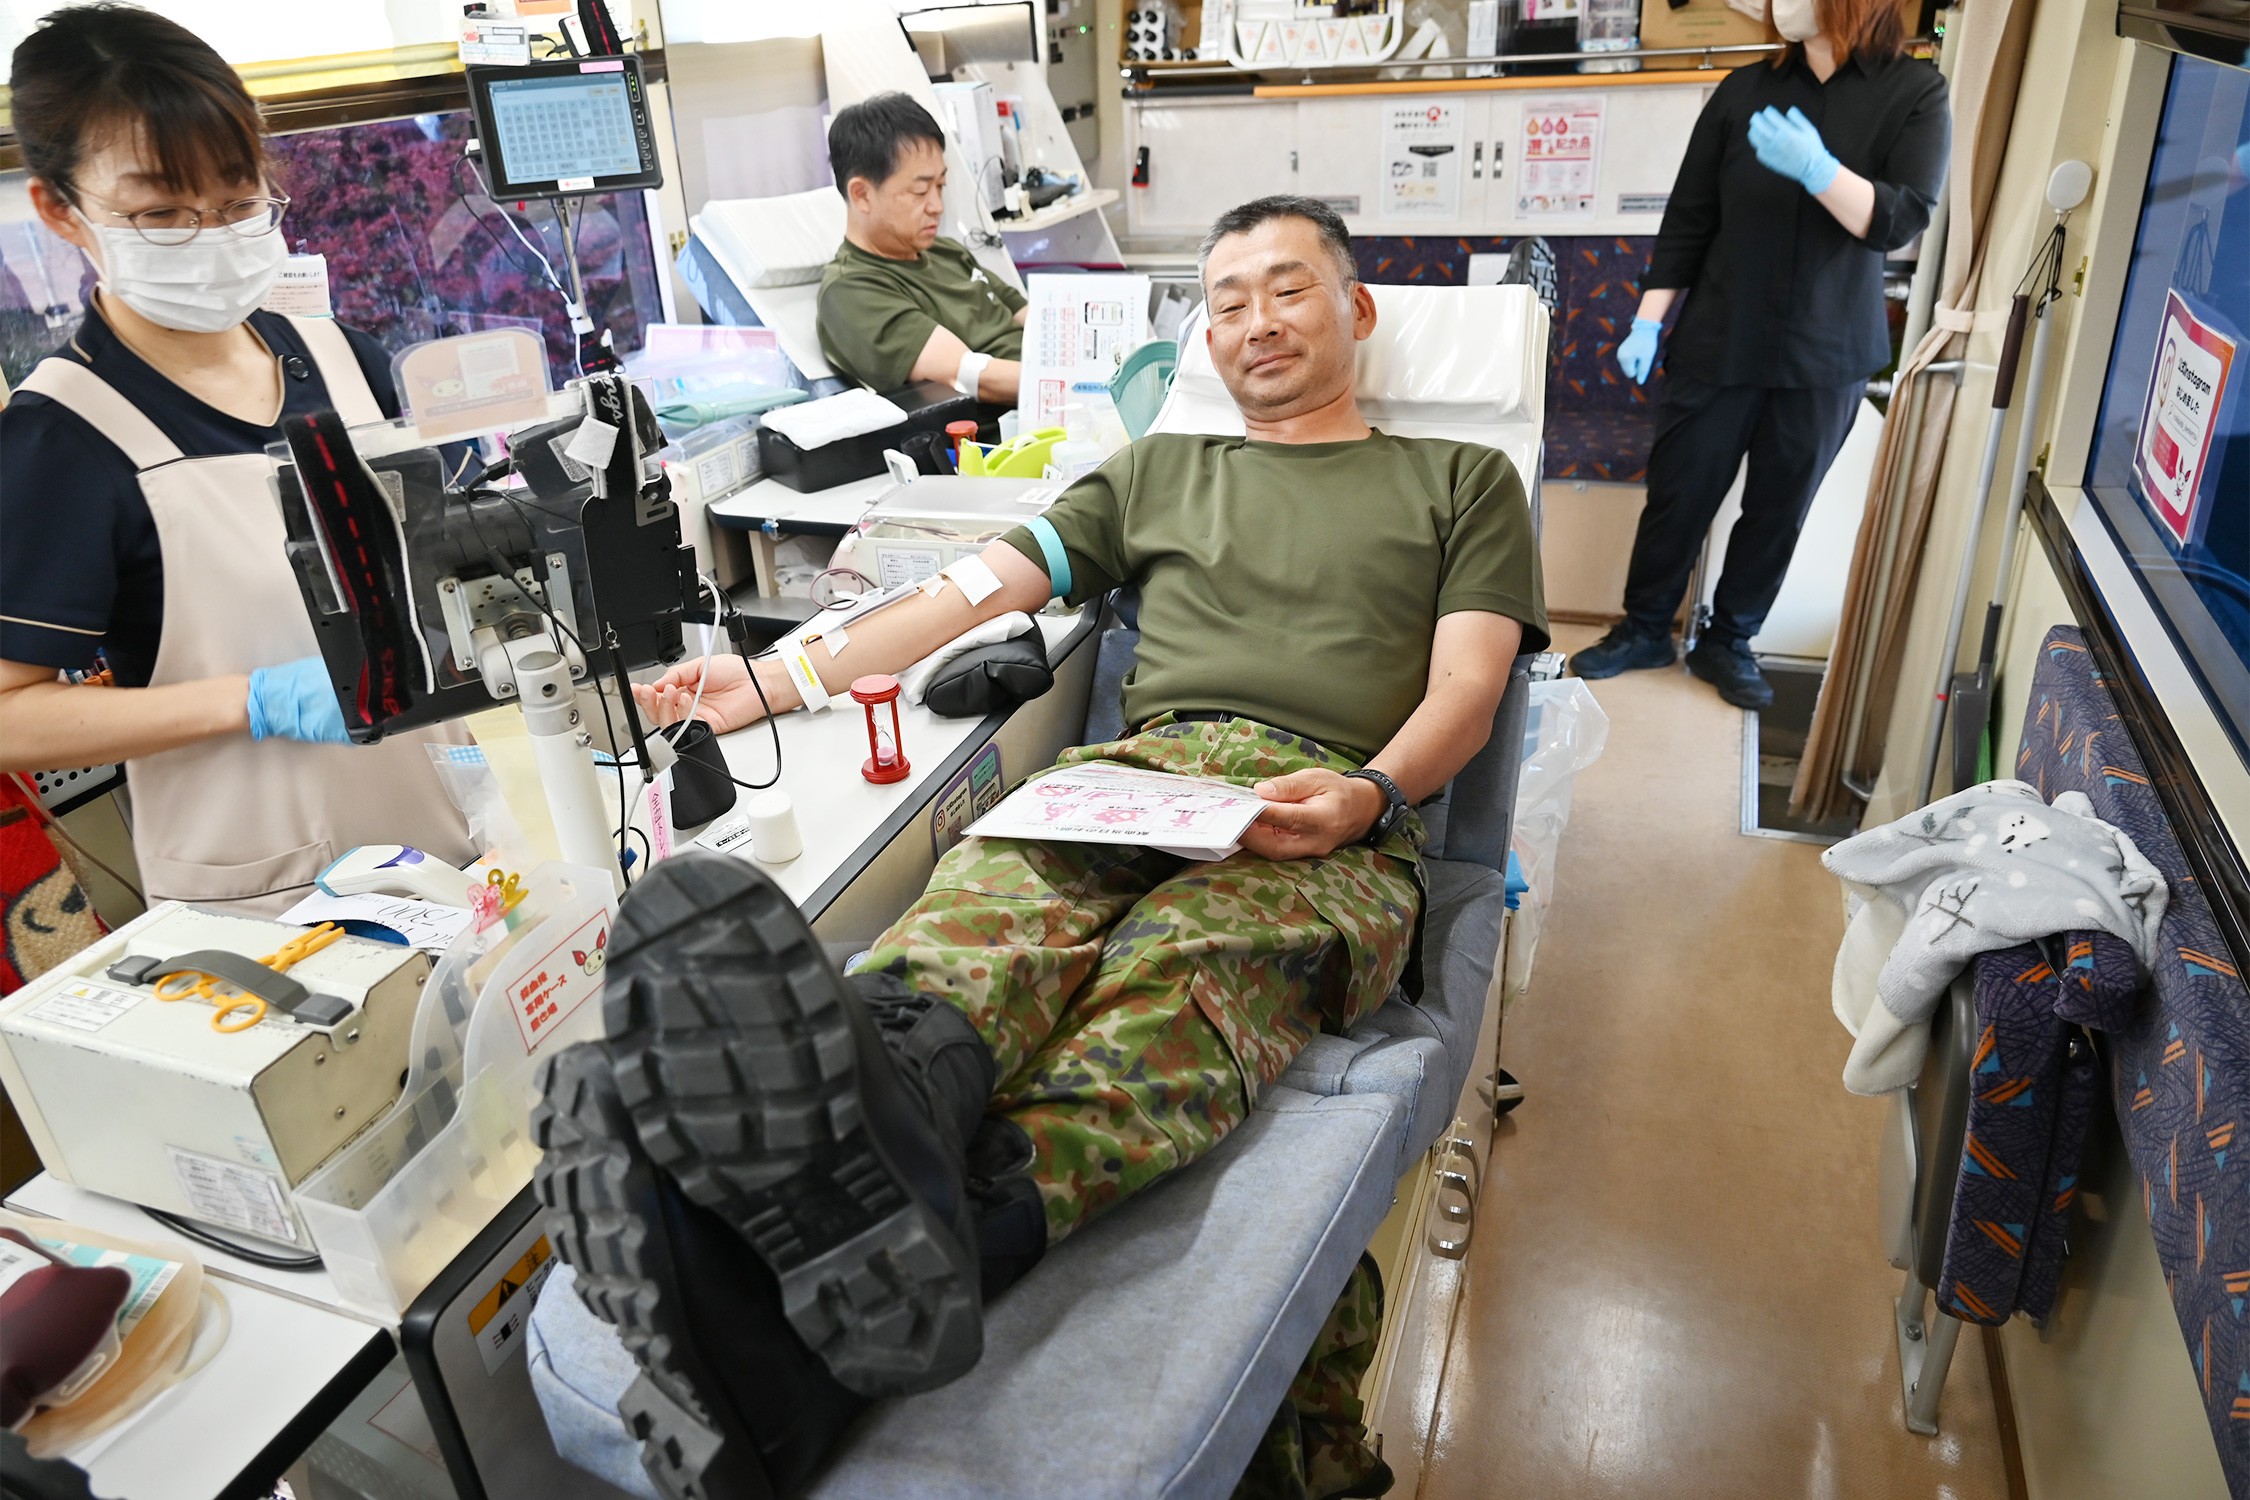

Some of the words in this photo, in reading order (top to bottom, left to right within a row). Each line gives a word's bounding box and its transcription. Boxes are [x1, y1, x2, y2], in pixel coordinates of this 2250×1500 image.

[2175, 385, 2200, 415] はじめました
[525, 974, 567, 1016] 専用ケース
